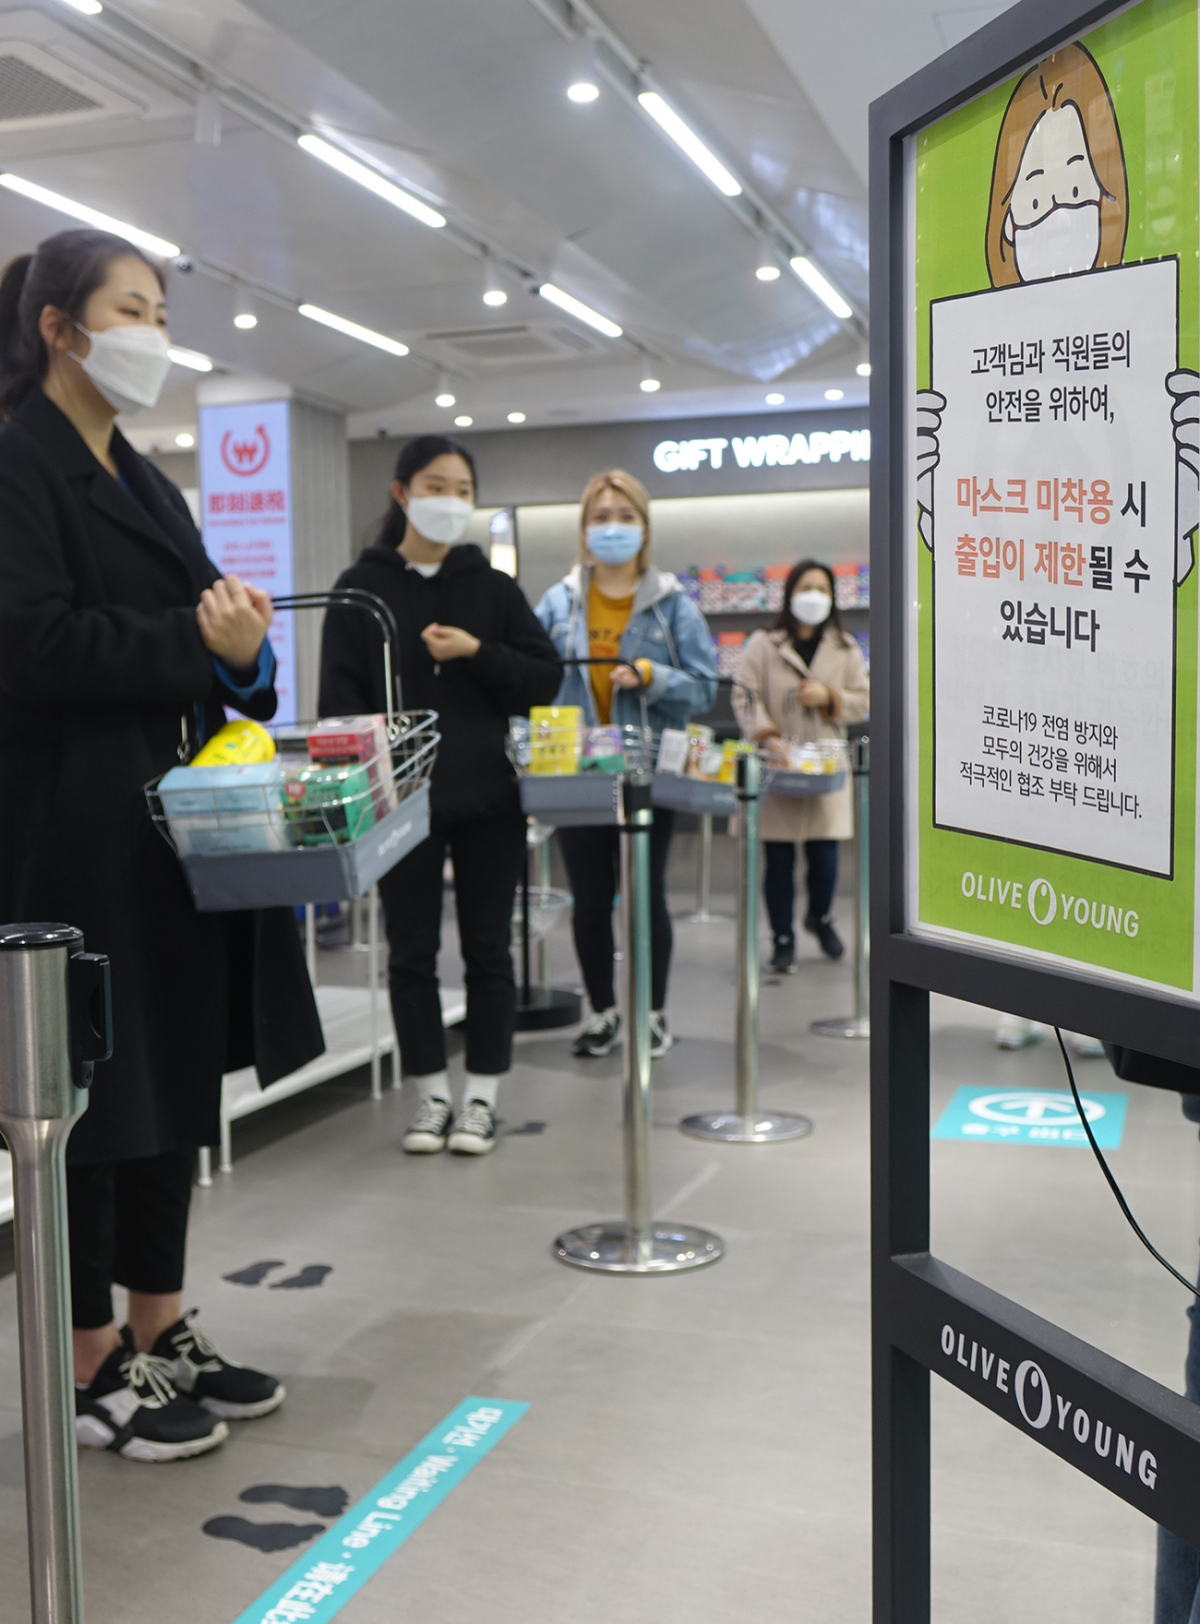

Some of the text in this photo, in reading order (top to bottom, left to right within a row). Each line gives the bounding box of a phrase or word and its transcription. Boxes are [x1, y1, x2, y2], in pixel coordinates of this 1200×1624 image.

[971, 330, 1130, 376] 고객님과 직원들의
[986, 385, 1114, 423] 안전을 위하여,
[654, 438, 728, 472] GIFT
[958, 476, 1146, 527] 마스크 미착용 시
[956, 534, 1150, 593] 출입이 제한될 수
[1001, 601, 1100, 652] 있습니다
[982, 706, 1118, 750] 코로나19 전염 방지와
[983, 736, 1116, 782] 모두의 건강을 위해서
[960, 762, 1141, 819] 적극적인 협조 부탁 드립니다.
[960, 872, 1022, 908] OLIVE
[1061, 893, 1138, 937] YOUNG
[941, 1324, 1010, 1394] OLIVE
[1057, 1395, 1157, 1489] YOUNG
[260, 1407, 503, 1624] 대기선 Waiting Line 请在此
